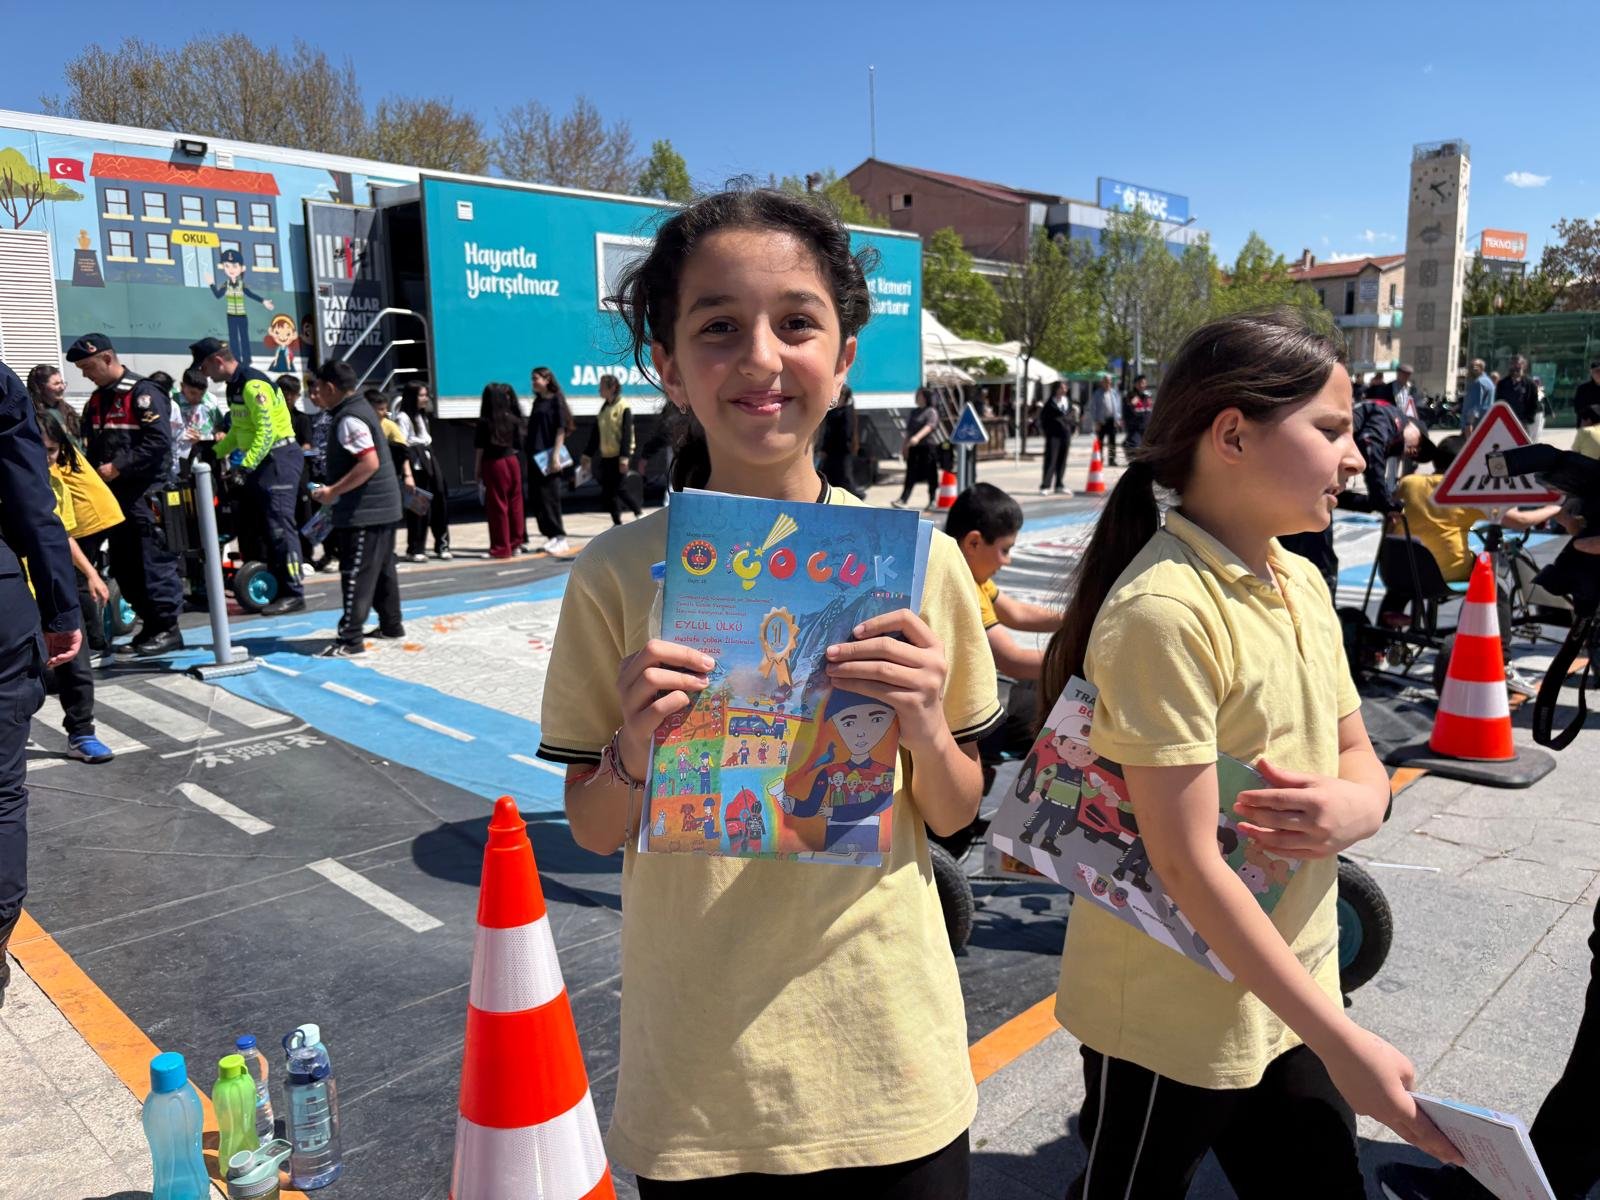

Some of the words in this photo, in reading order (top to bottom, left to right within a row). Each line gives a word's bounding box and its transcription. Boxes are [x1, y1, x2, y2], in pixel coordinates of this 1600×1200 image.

[182, 233, 208, 245] OKUL
[464, 241, 537, 273] Hayatla
[466, 269, 560, 300] Yarışılmaz
[323, 295, 380, 311] YAYALAR
[732, 547, 899, 591] ÇOCUK
[675, 619, 711, 631] EYLÜL
[716, 619, 743, 632] ÜLKÜ
